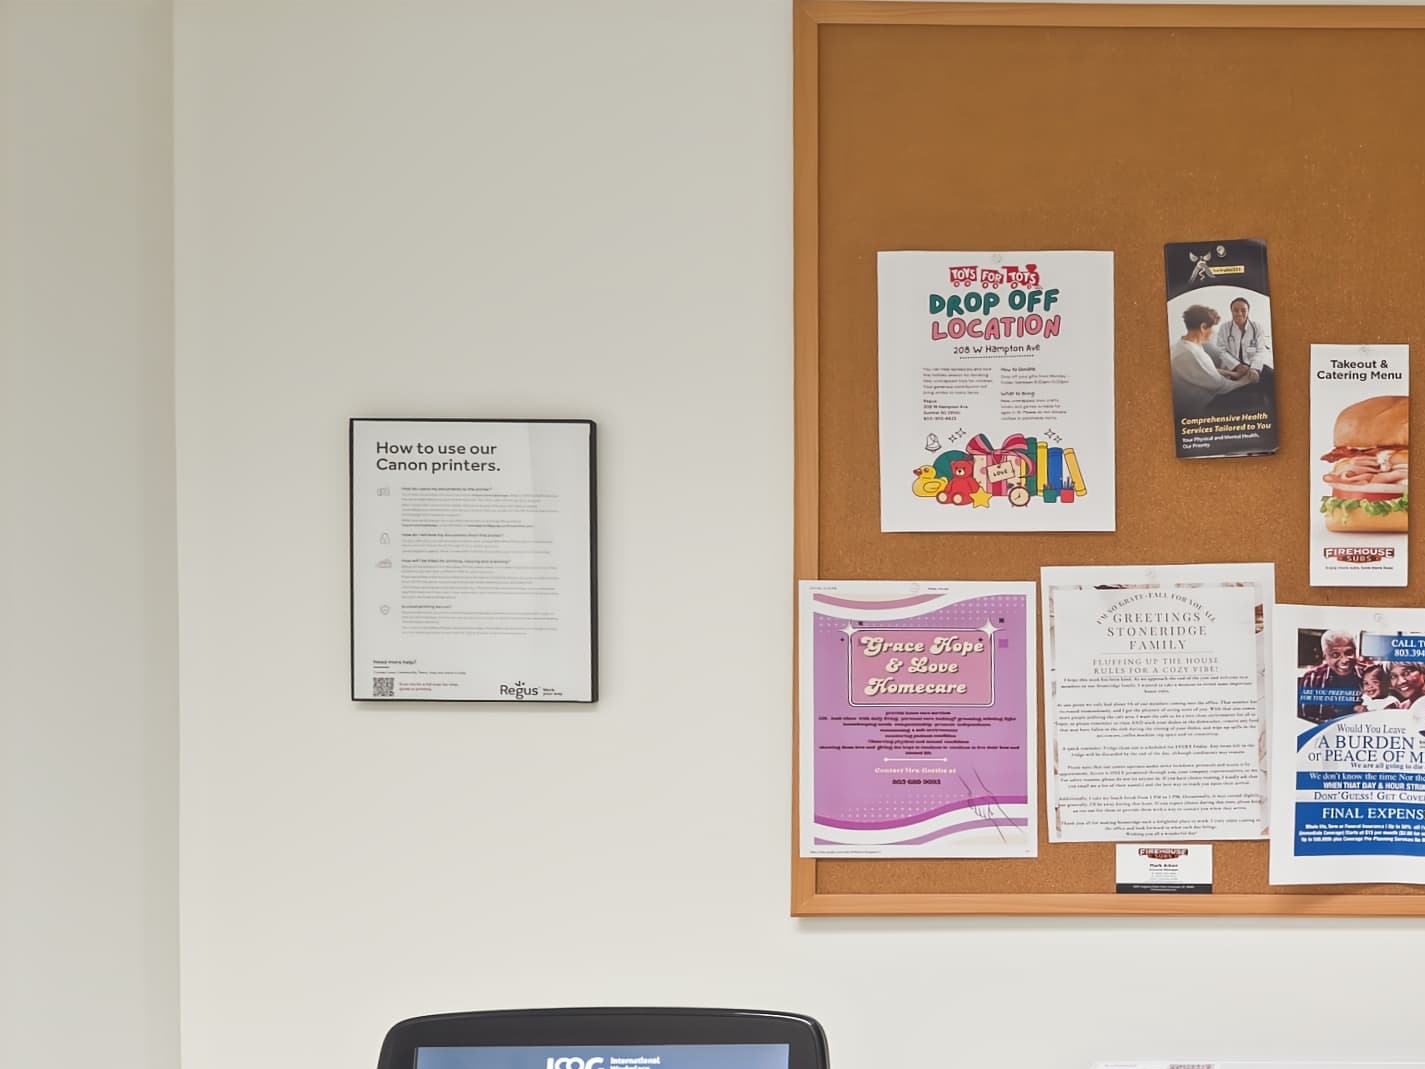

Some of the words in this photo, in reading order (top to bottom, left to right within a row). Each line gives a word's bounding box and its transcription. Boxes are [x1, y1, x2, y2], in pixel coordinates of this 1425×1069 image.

[951, 268, 976, 280] TOYS
[982, 272, 1002, 282] FOR
[1008, 271, 1036, 284] TOTS
[929, 292, 1000, 317] DROP
[1008, 289, 1059, 312] OFF
[931, 314, 1061, 340] LOCATION
[953, 346, 970, 354] 208
[986, 345, 1024, 355] Hampton
[1330, 360, 1377, 368] Takeout
[1380, 360, 1388, 368] &
[1317, 371, 1367, 381] Catering
[1371, 371, 1402, 379] Menu
[1181, 415, 1240, 425] Comprehensive
[1242, 412, 1268, 420] Health
[1182, 427, 1212, 435] Services
[1214, 423, 1245, 432] Tailored
[376, 441, 413, 454] How
[417, 442, 434, 454] to
[438, 445, 466, 454] use
[470, 445, 497, 455] our
[376, 458, 427, 471] Canon
[431, 459, 501, 474] printers.
[1326, 548, 1393, 558] FIREHOUSE
[1113, 612, 1201, 623] GREETINGS
[1107, 626, 1207, 637] STONERIDGE
[860, 636, 925, 657] Grace
[930, 636, 984, 656] Hope
[1129, 640, 1186, 650] FAMILY
[886, 658, 903, 673] &
[908, 657, 958, 673] Love
[499, 683, 538, 699] Regus
[864, 677, 967, 696] Homecare
[1337, 724, 1363, 733] Would
[1366, 725, 1381, 733] You
[1383, 725, 1406, 734] Leave
[1318, 736, 1329, 748] A
[1336, 736, 1414, 749] BURDEN
[1325, 750, 1377, 762] PEACE
[1383, 751, 1404, 762] OF
[1322, 808, 1364, 819] FINAL
[610, 1056, 660, 1064] International
